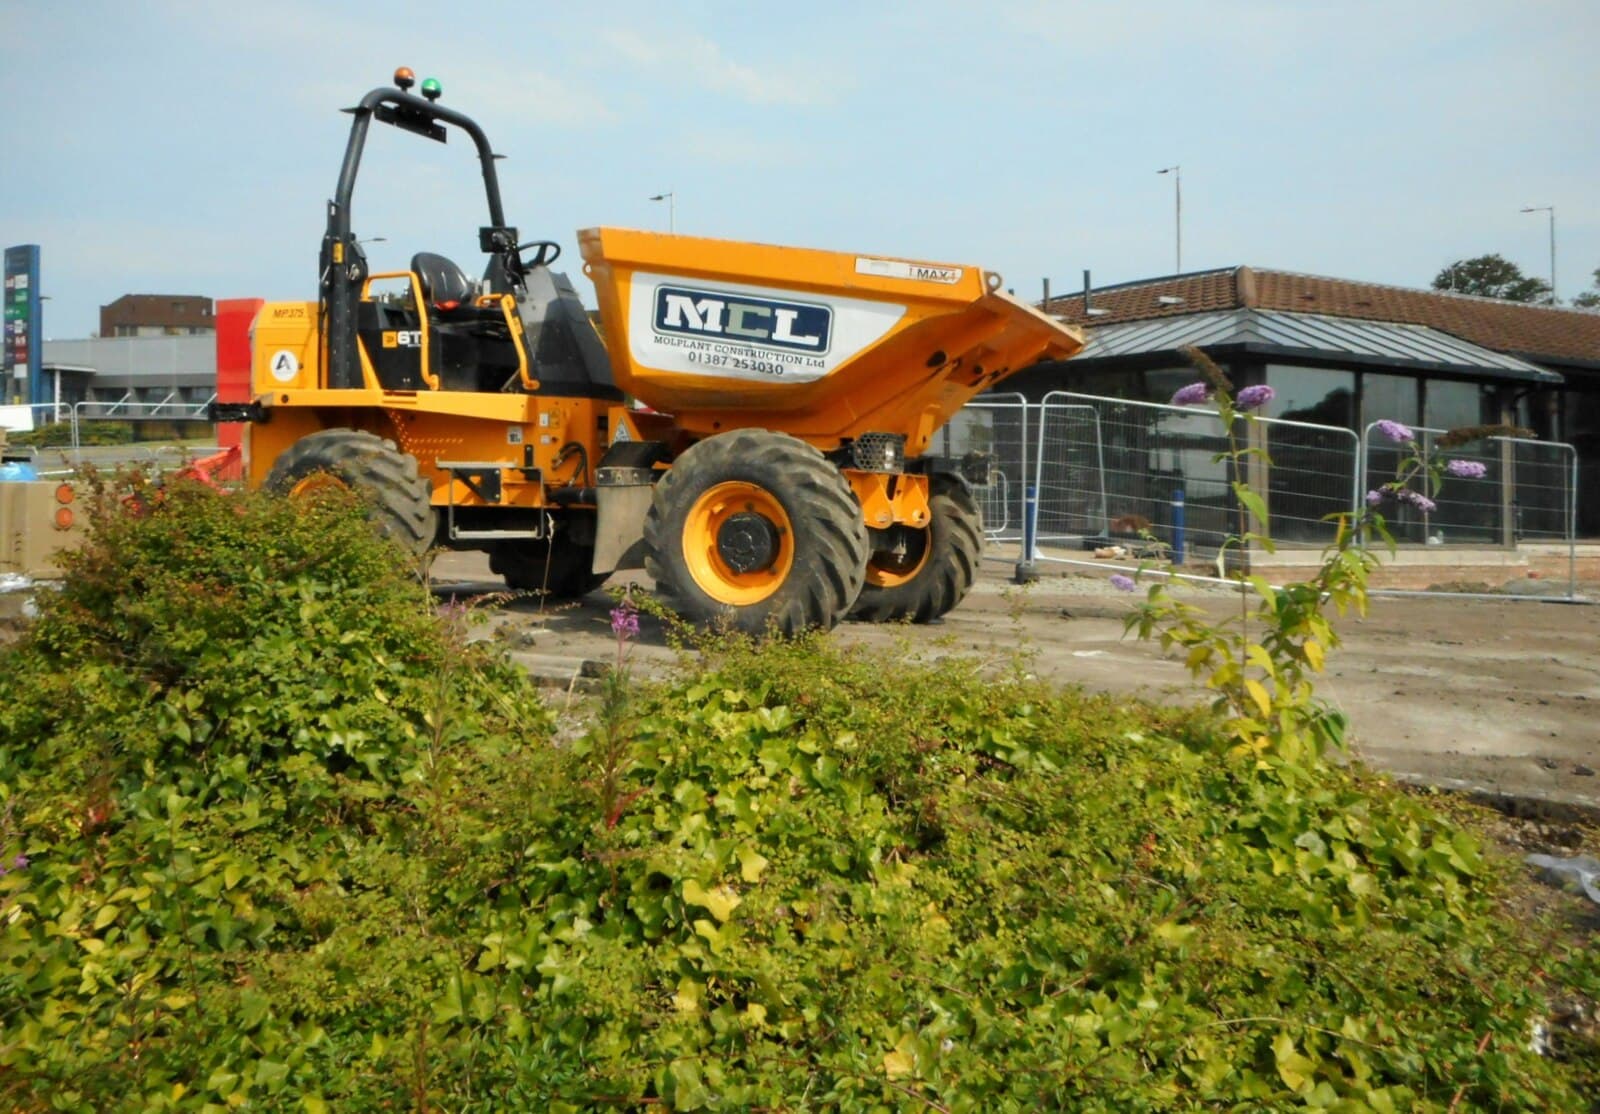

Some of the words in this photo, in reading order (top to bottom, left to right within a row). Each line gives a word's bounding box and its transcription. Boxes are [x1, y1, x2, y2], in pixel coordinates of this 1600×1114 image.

[663, 294, 820, 346] MCL
[653, 335, 712, 352] MOLPLANT
[714, 344, 804, 365] CONSTRUCTION
[806, 358, 825, 369] Ltd
[688, 351, 728, 366] 01387
[732, 358, 785, 376] 253030
